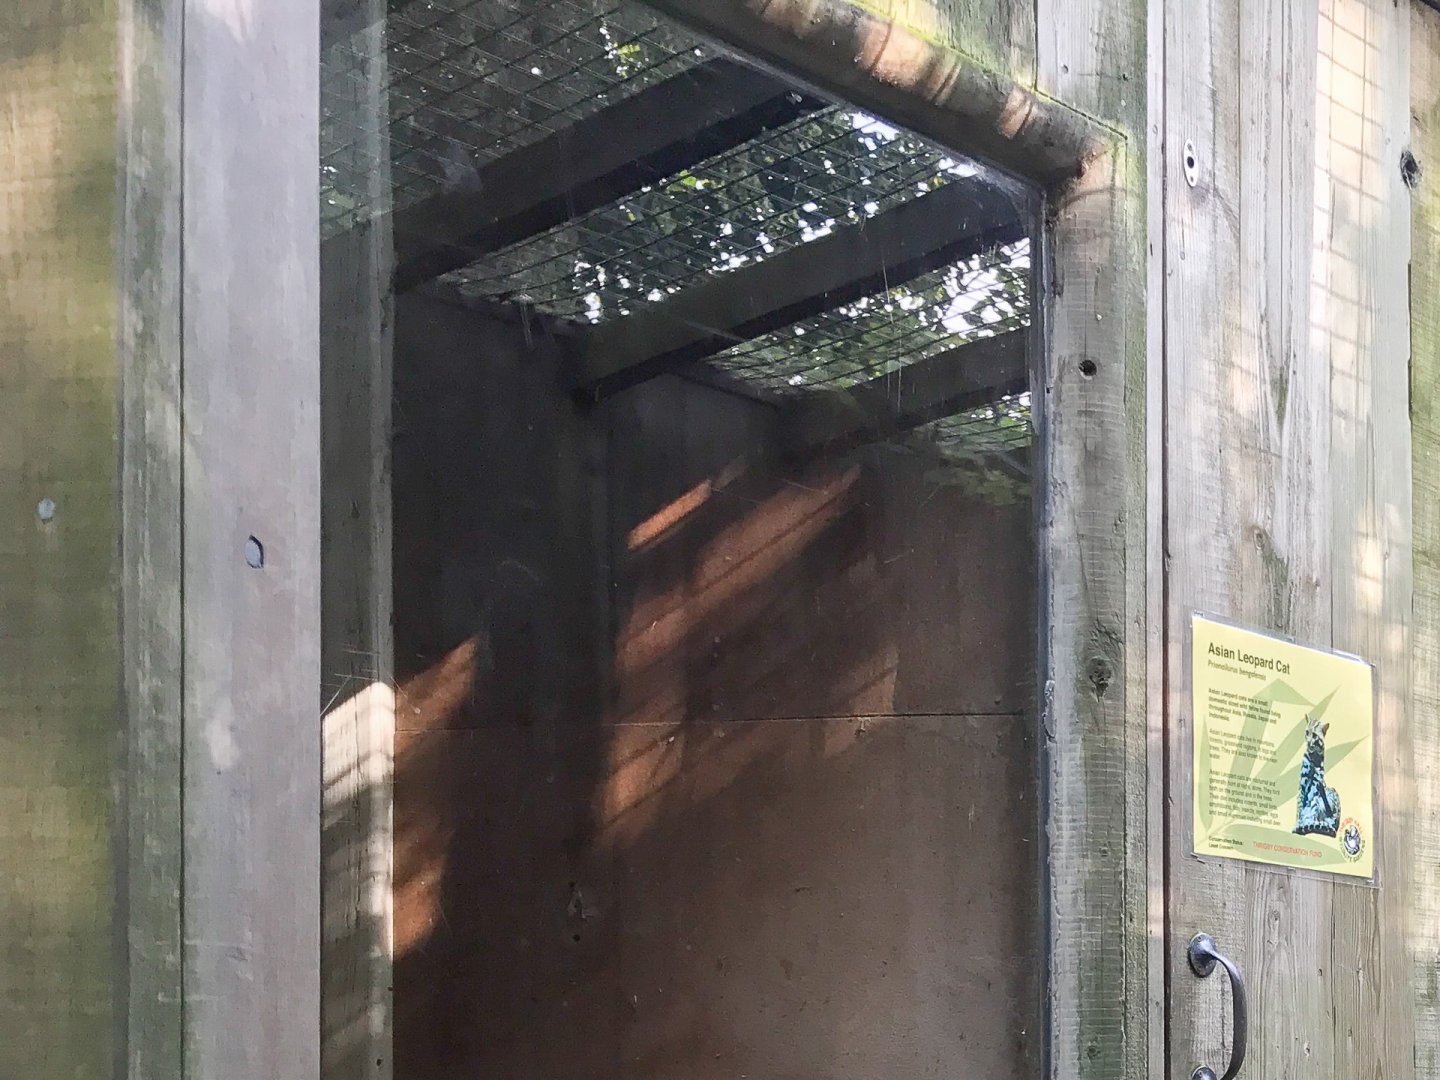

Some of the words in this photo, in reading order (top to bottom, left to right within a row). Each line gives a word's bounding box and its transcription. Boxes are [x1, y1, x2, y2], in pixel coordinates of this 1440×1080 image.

[1208, 642, 1235, 660] Asian
[1237, 649, 1274, 670] Leopard
[1276, 660, 1290, 675] Cat
